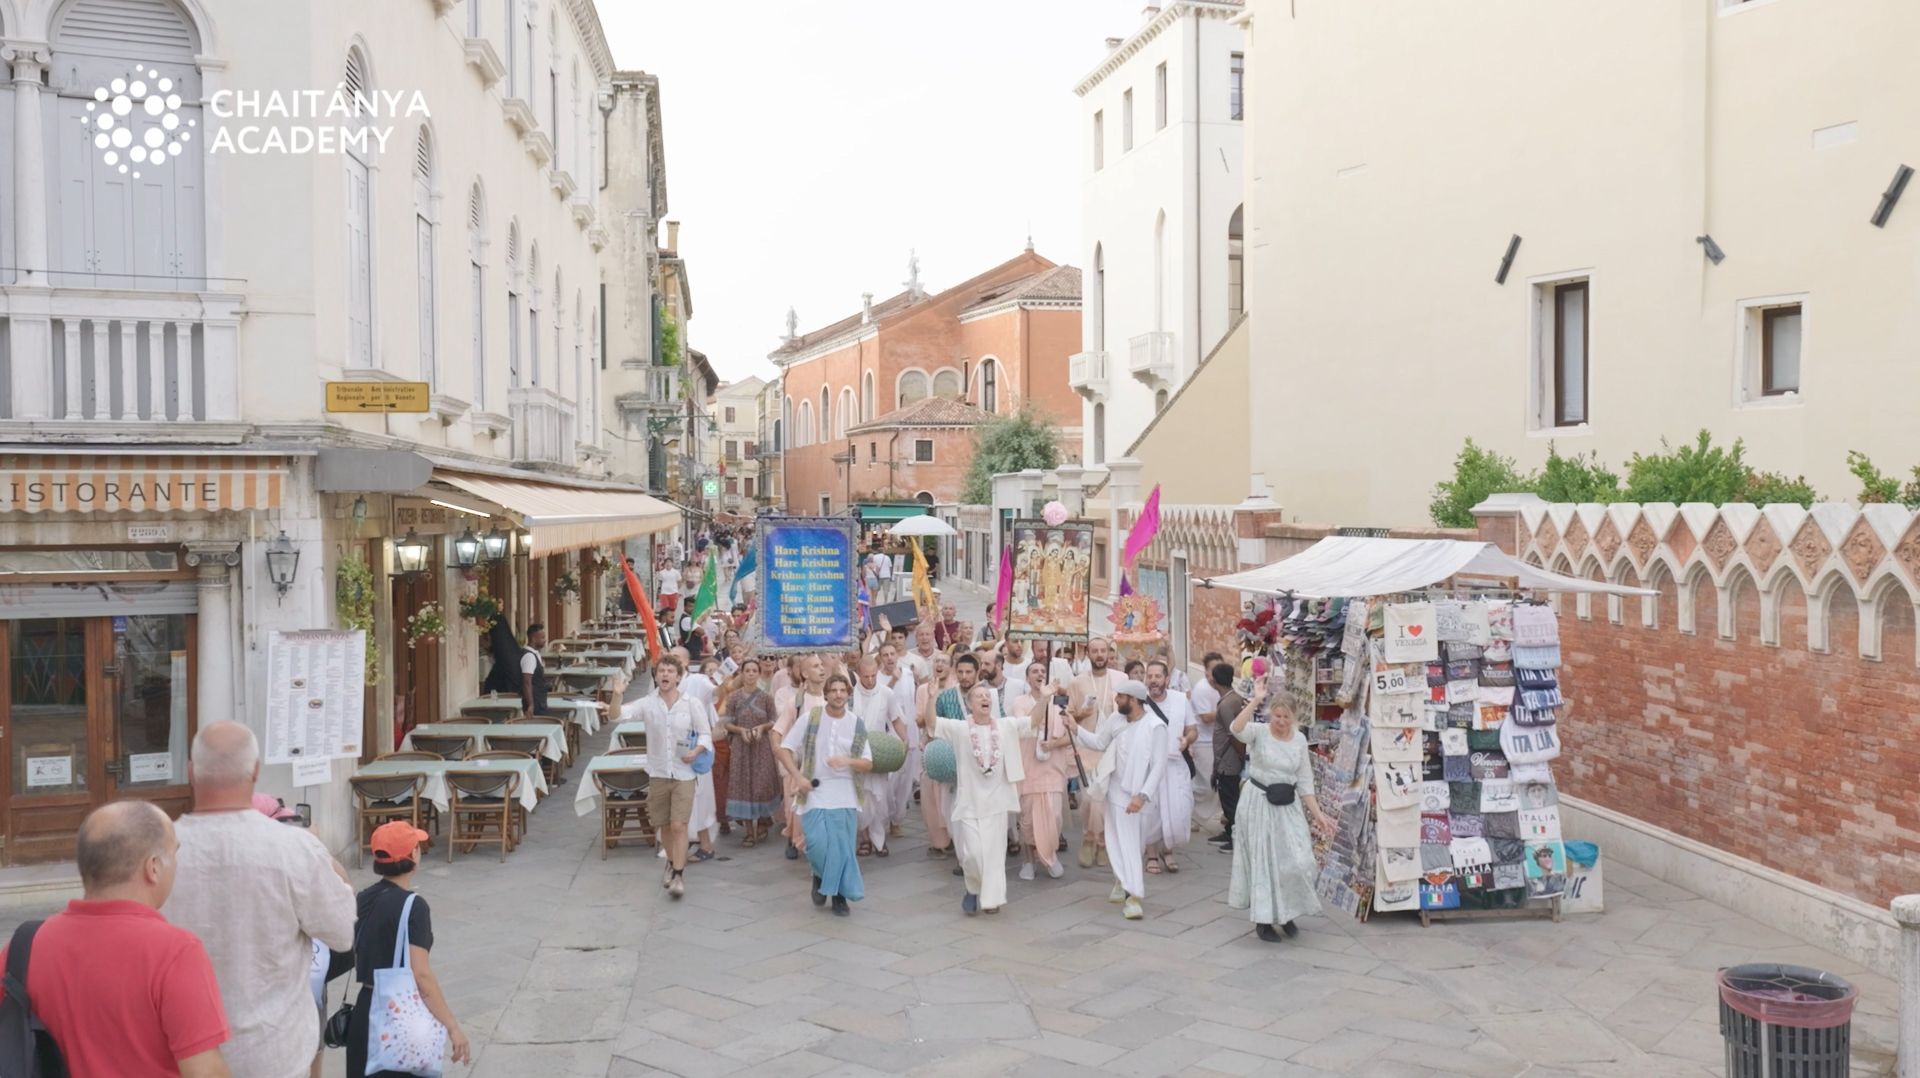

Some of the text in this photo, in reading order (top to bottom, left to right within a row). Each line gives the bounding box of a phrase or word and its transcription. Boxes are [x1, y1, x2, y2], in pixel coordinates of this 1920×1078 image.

[0, 482, 217, 503] ISTORANTE
[775, 545, 840, 555] Hare Krishna
[775, 557, 839, 568] Hare Krishna
[771, 571, 844, 580] Krishna Krishna
[782, 581, 832, 592] Hare Hare
[781, 594, 833, 603] Hare Rama
[781, 604, 833, 614] Hare Rama
[781, 615, 835, 625] Rama Rama
[783, 625, 832, 635] Hare Hare
[1398, 626, 1405, 638] I
